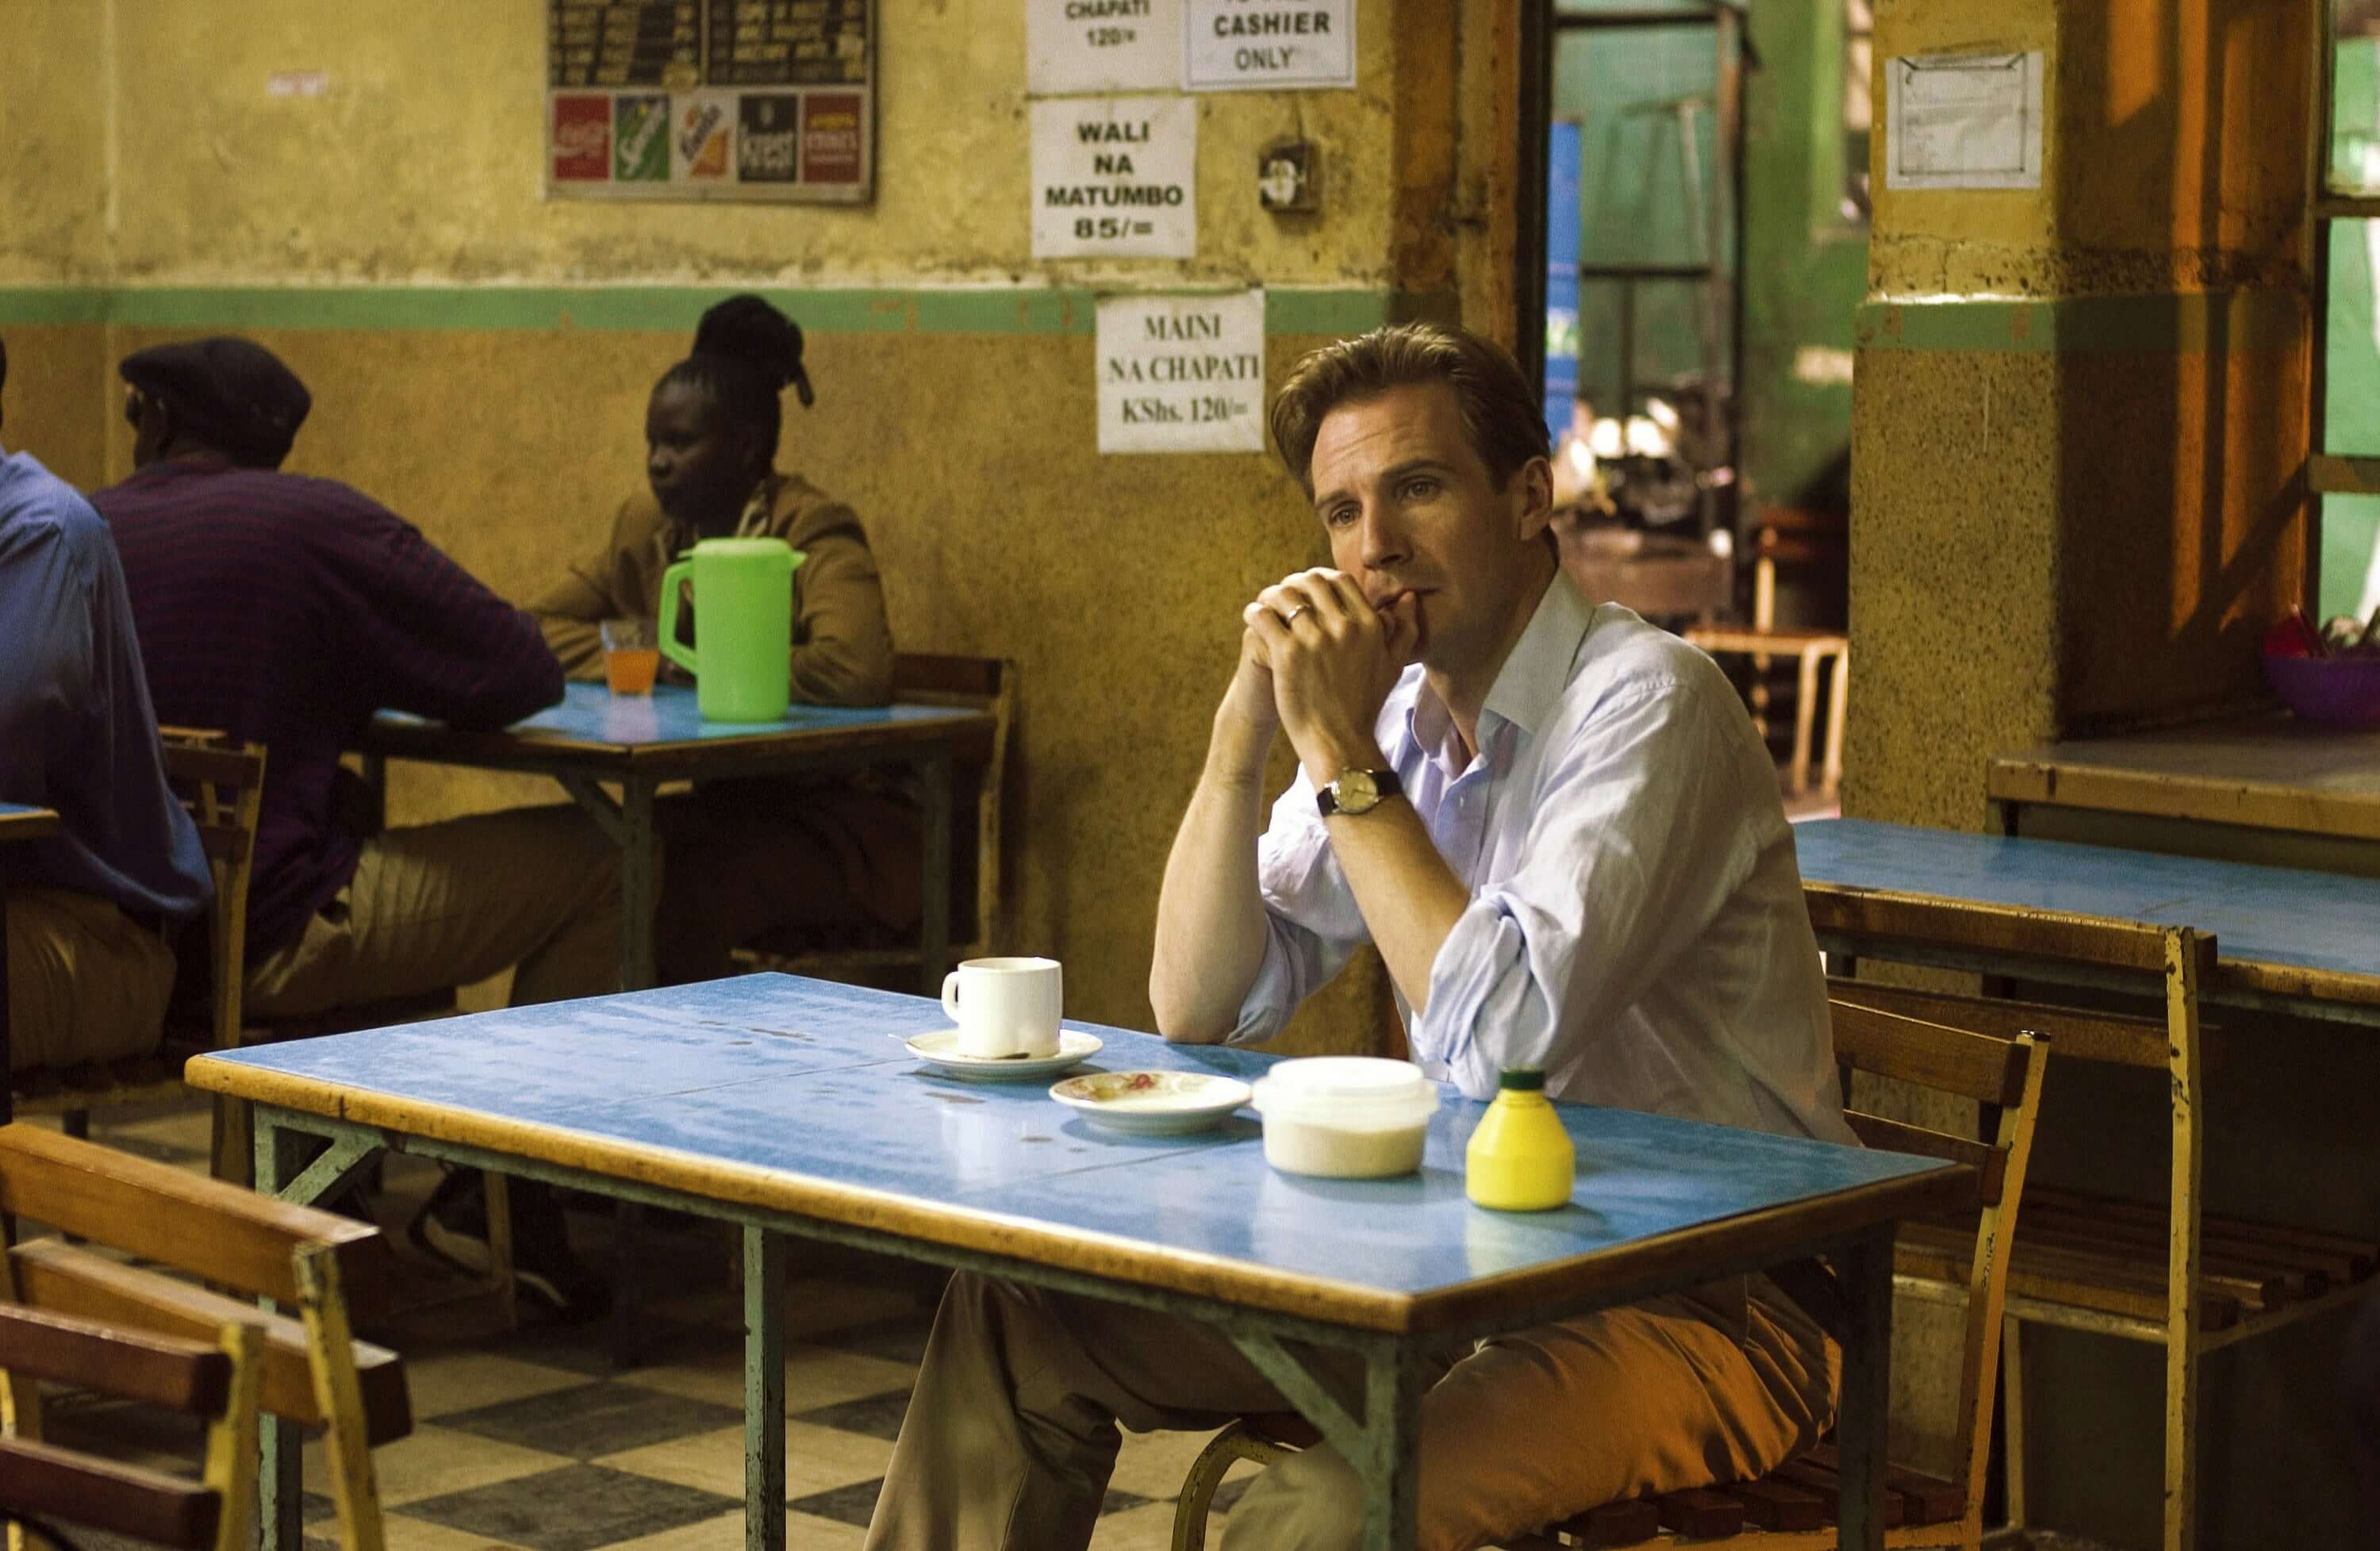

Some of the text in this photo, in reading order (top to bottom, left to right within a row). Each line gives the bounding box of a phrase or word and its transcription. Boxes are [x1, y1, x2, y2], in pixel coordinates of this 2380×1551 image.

[1065, 0, 1150, 20] CHAPATI
[1214, 10, 1330, 38] CASHIER
[1234, 46, 1296, 71] ONLY
[1077, 121, 1150, 144] WALI
[1094, 154, 1134, 175] NA
[1045, 185, 1184, 207] MATUMBO
[1074, 217, 1154, 239] 85/=
[1144, 314, 1222, 341] MAINI
[1122, 398, 1183, 424] KShs.
